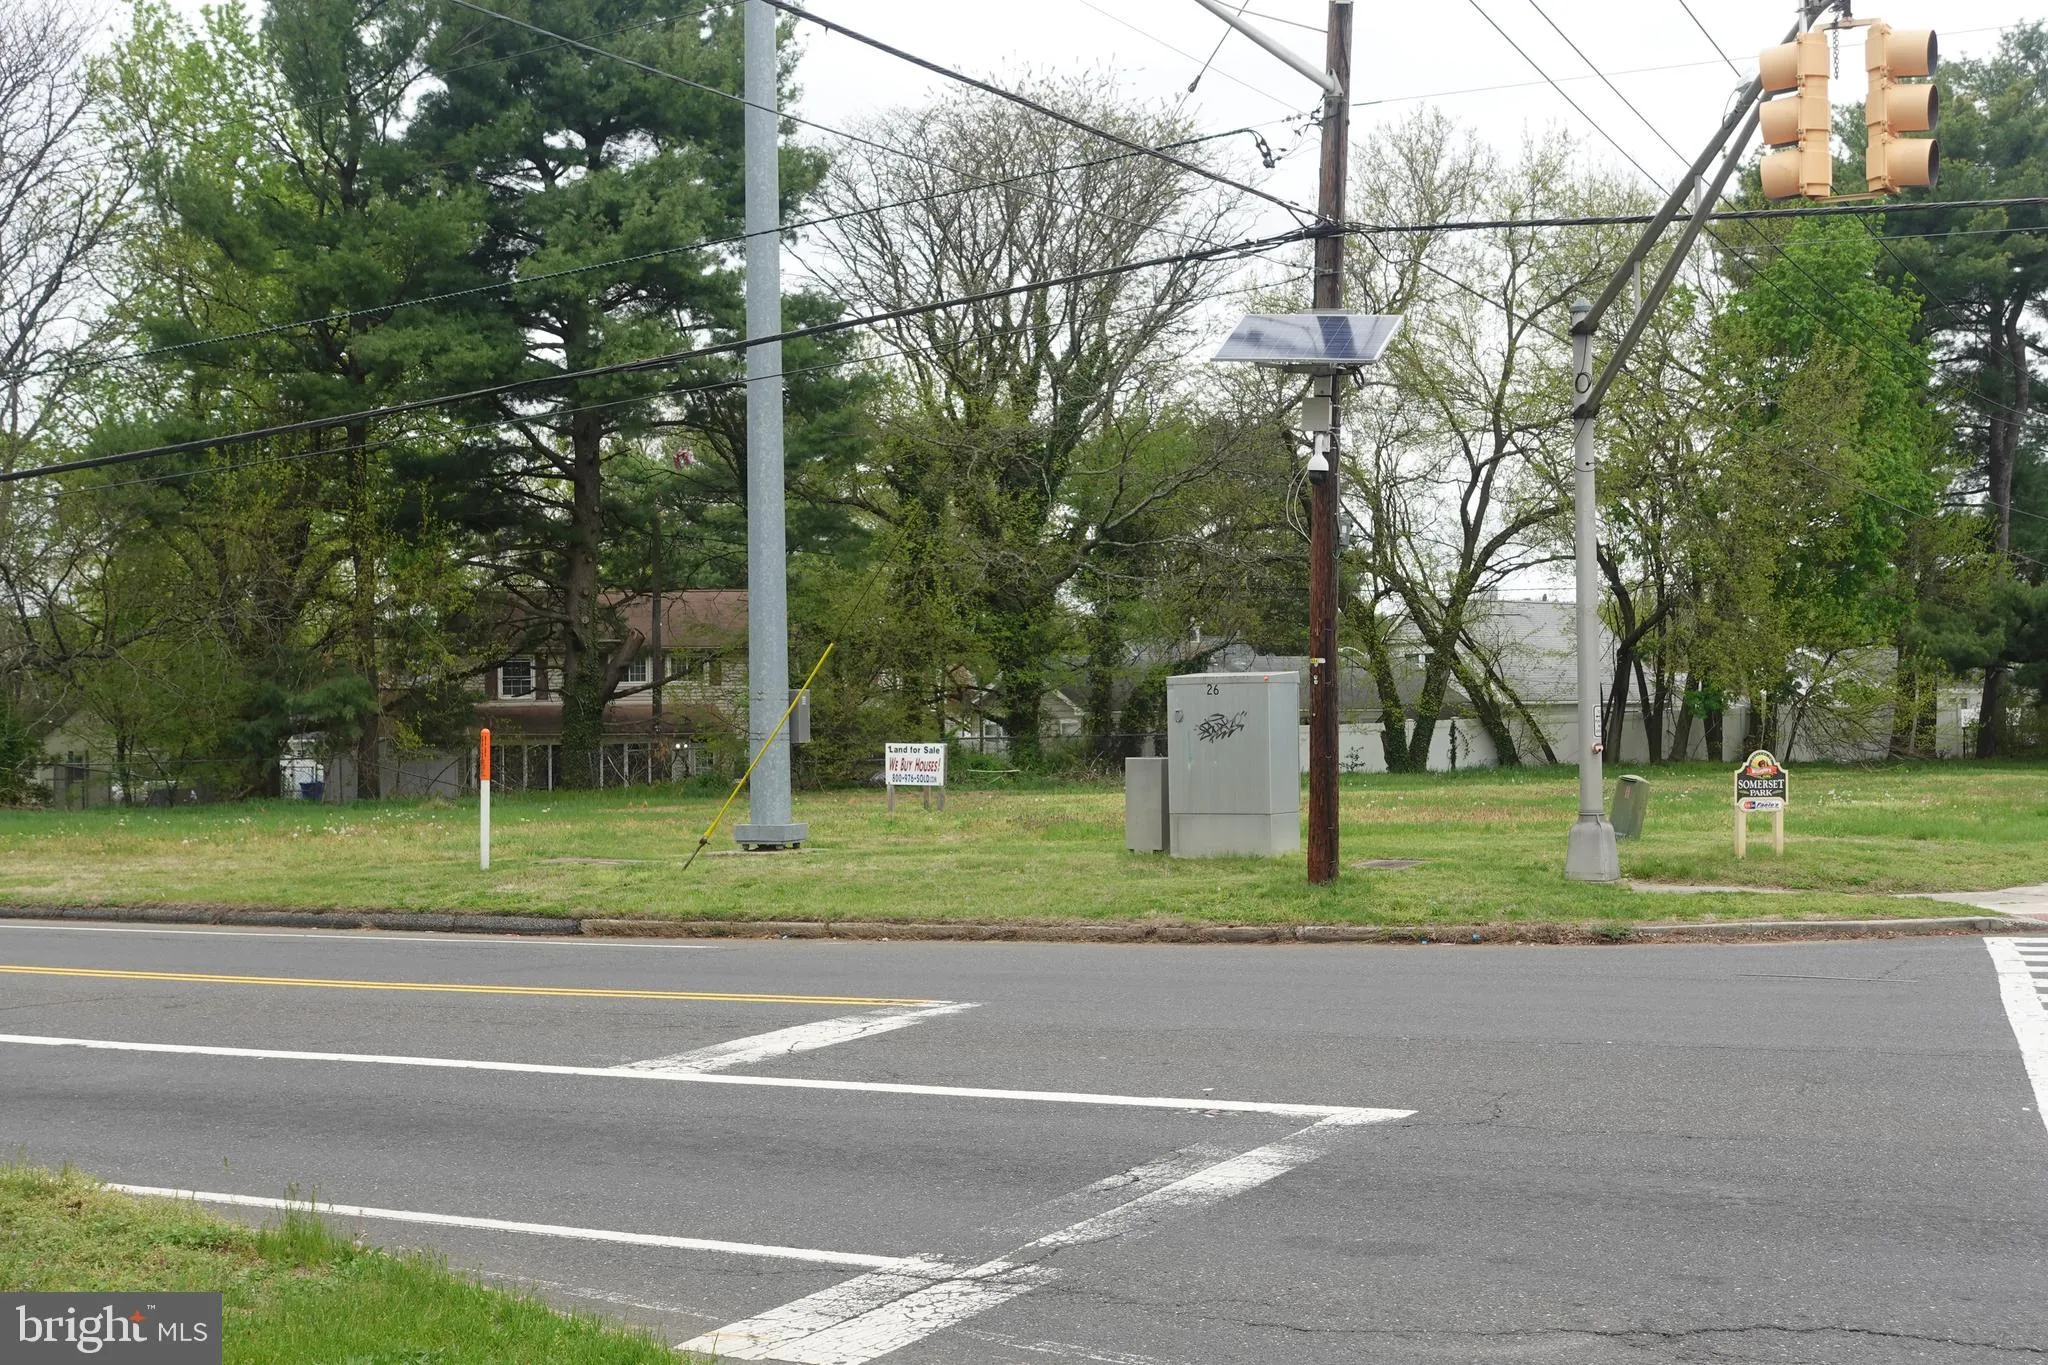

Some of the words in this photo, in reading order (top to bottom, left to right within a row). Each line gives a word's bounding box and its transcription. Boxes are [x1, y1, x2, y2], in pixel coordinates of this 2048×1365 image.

[1206, 683, 1220, 696] 26
[888, 745, 908, 754] Land
[910, 746, 921, 754] for
[923, 746, 941, 754] Sale
[1738, 779, 1785, 790] SOMERSET
[1749, 789, 1773, 797] PARK
